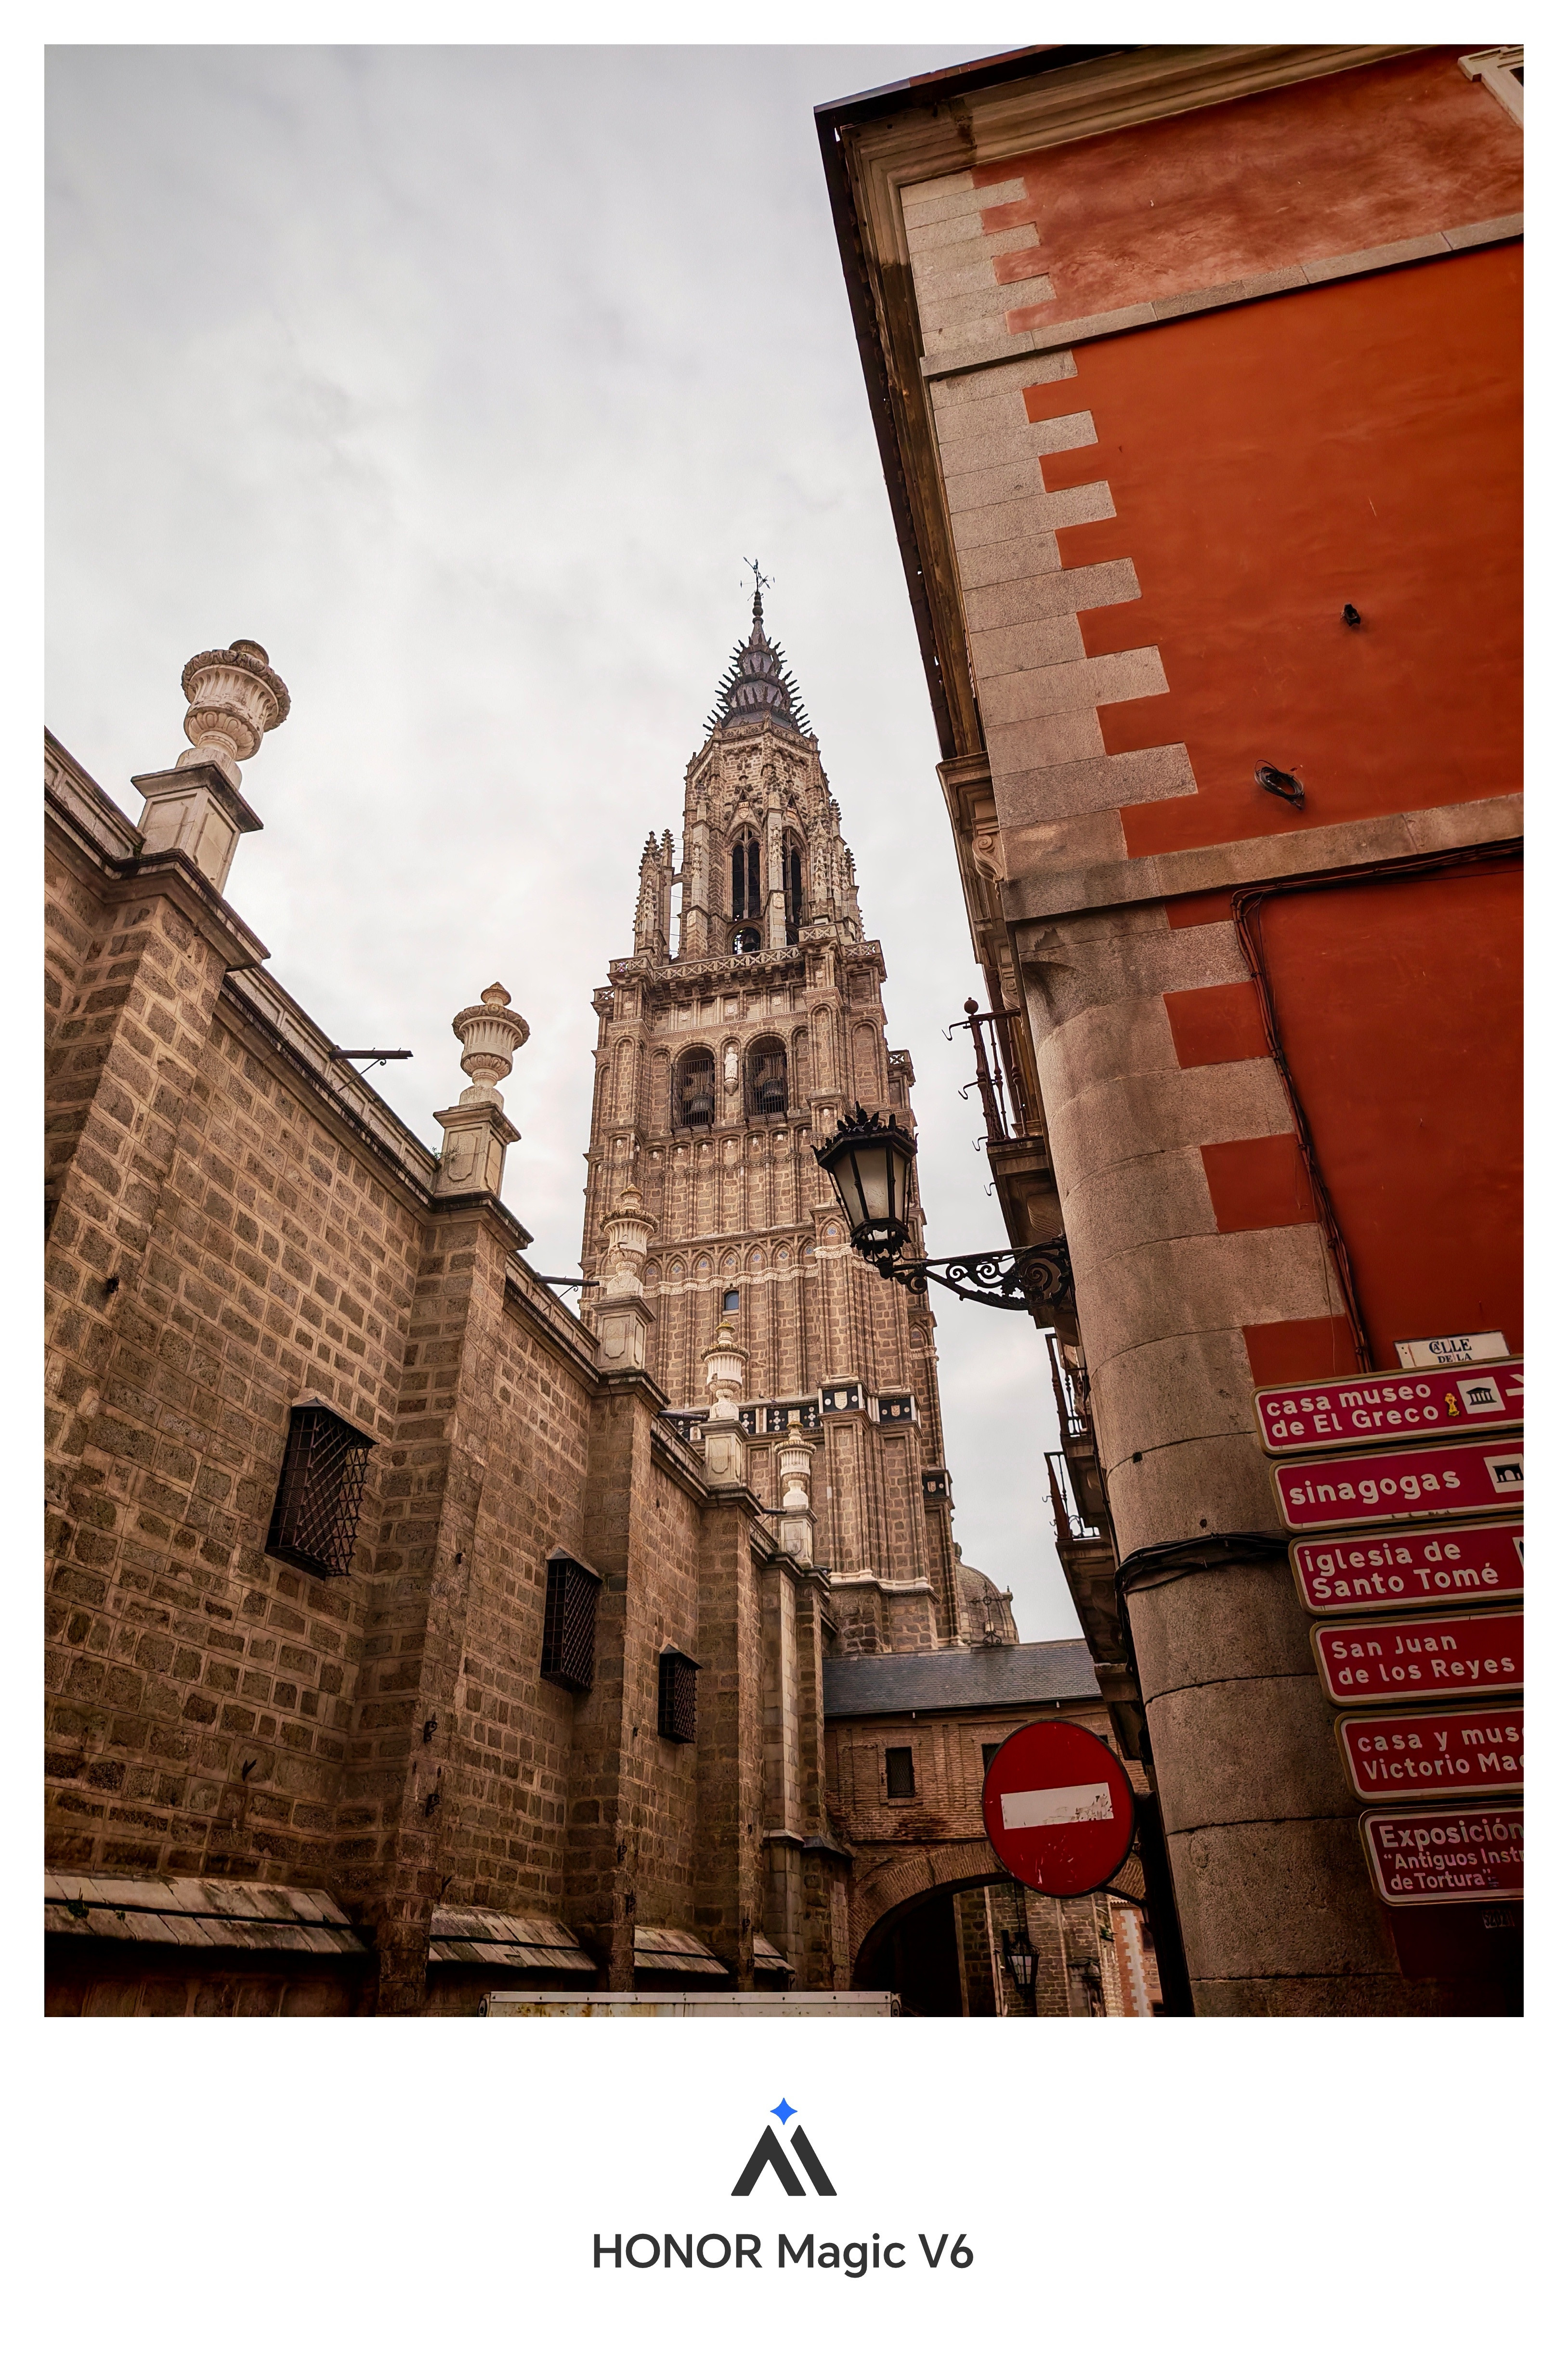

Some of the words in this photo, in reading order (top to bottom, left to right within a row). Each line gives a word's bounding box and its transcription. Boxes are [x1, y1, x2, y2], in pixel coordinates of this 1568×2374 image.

[1429, 1338, 1472, 1354] CALLE
[1456, 1353, 1473, 1362] LA
[1267, 1396, 1331, 1417] casa
[1339, 1384, 1431, 1408] museo
[1272, 1420, 1304, 1437] de
[1313, 1413, 1343, 1432] El
[1352, 1405, 1438, 1428] Greco
[1290, 1471, 1460, 1505] sinagogas
[1304, 1543, 1412, 1576] iglesia
[1424, 1541, 1461, 1561] de
[1313, 1572, 1404, 1598] Santo
[1413, 1563, 1499, 1589] Tomé
[1332, 1641, 1382, 1659] San
[1396, 1636, 1457, 1654] Juan
[1339, 1667, 1369, 1684] de
[1379, 1664, 1421, 1681] los
[1431, 1658, 1515, 1679] Reyes
[1358, 1734, 1422, 1752] casa
[1434, 1731, 1447, 1751] y
[1462, 1727, 1523, 1744] mus
[1363, 1754, 1469, 1779] Victorio
[1379, 1818, 1523, 1851] Exposición
[1384, 1851, 1477, 1870] “Antiguos
[1391, 1874, 1413, 1890] de
[1414, 1869, 1490, 1888] Tortura”
